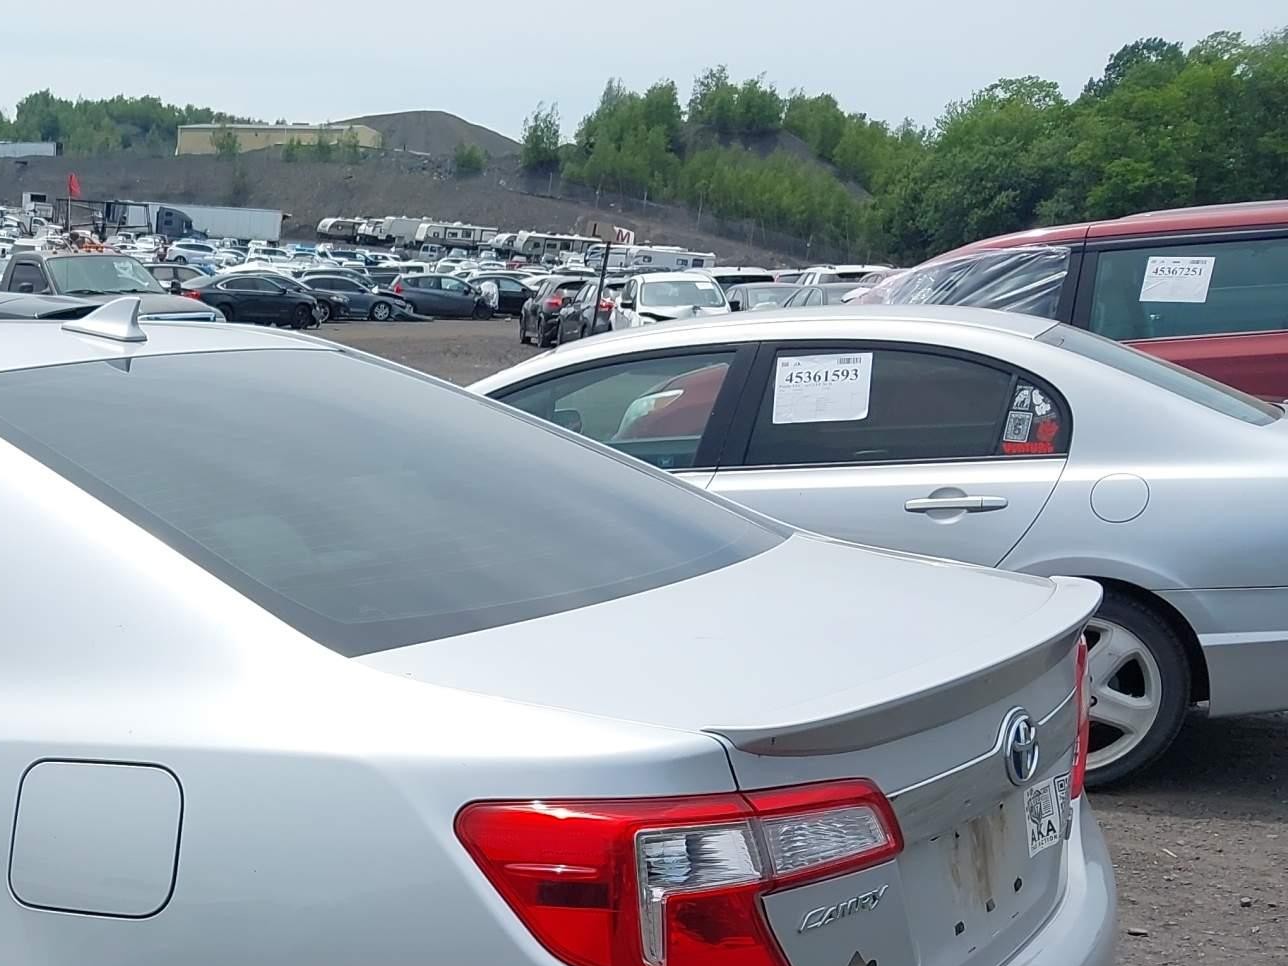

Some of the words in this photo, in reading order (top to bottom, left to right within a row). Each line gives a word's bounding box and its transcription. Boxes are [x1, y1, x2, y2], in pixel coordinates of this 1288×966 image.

[592, 223, 602, 238] L
[616, 229, 631, 243] M
[1152, 266, 1203, 276] 45367251
[785, 367, 860, 384] 45361593
